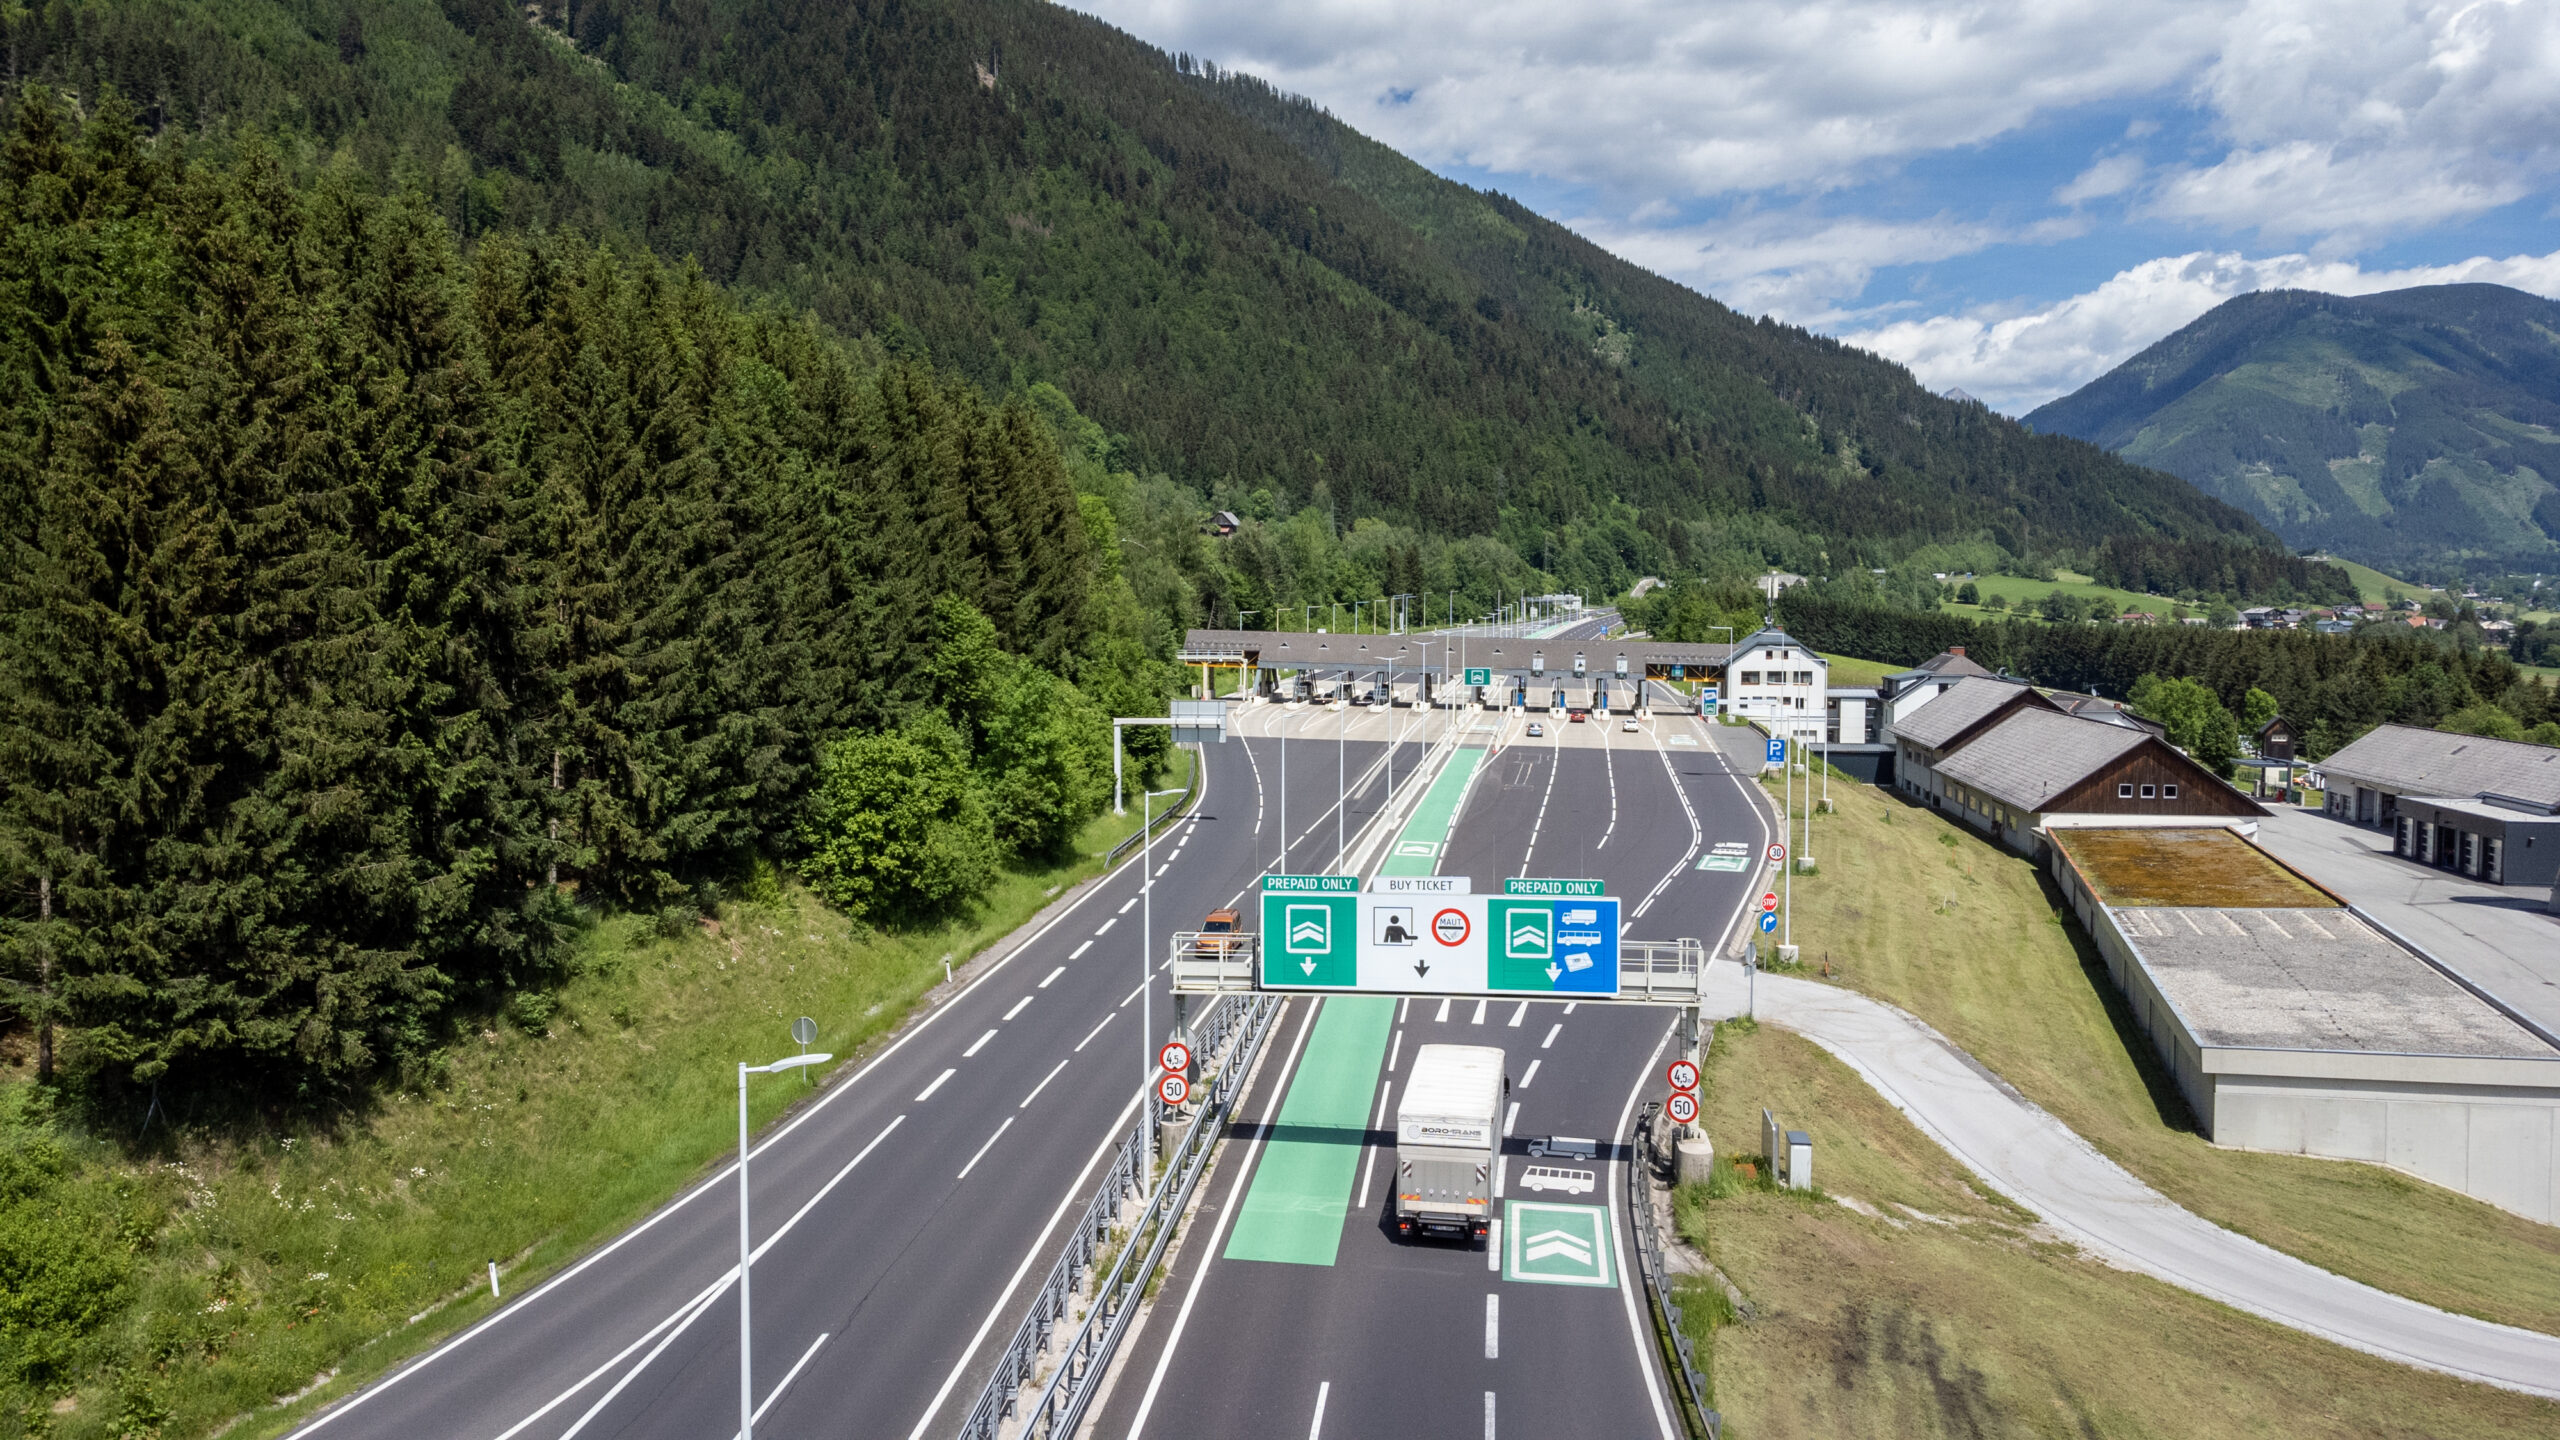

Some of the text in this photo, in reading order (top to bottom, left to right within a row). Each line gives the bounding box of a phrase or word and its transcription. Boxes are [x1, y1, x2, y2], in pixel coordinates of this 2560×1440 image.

[1770, 741, 1782, 756] P
[1771, 847, 1782, 857] 30
[1267, 877, 1353, 890] PREPAID ONLY
[1390, 880, 1454, 891] BUY TICKET
[1510, 881, 1598, 895] PREPAID ONLY
[1763, 898, 1776, 906] STOP
[1439, 918, 1462, 926] MAUT
[1166, 1082, 1182, 1097] 50
[1674, 1100, 1690, 1116] 50
